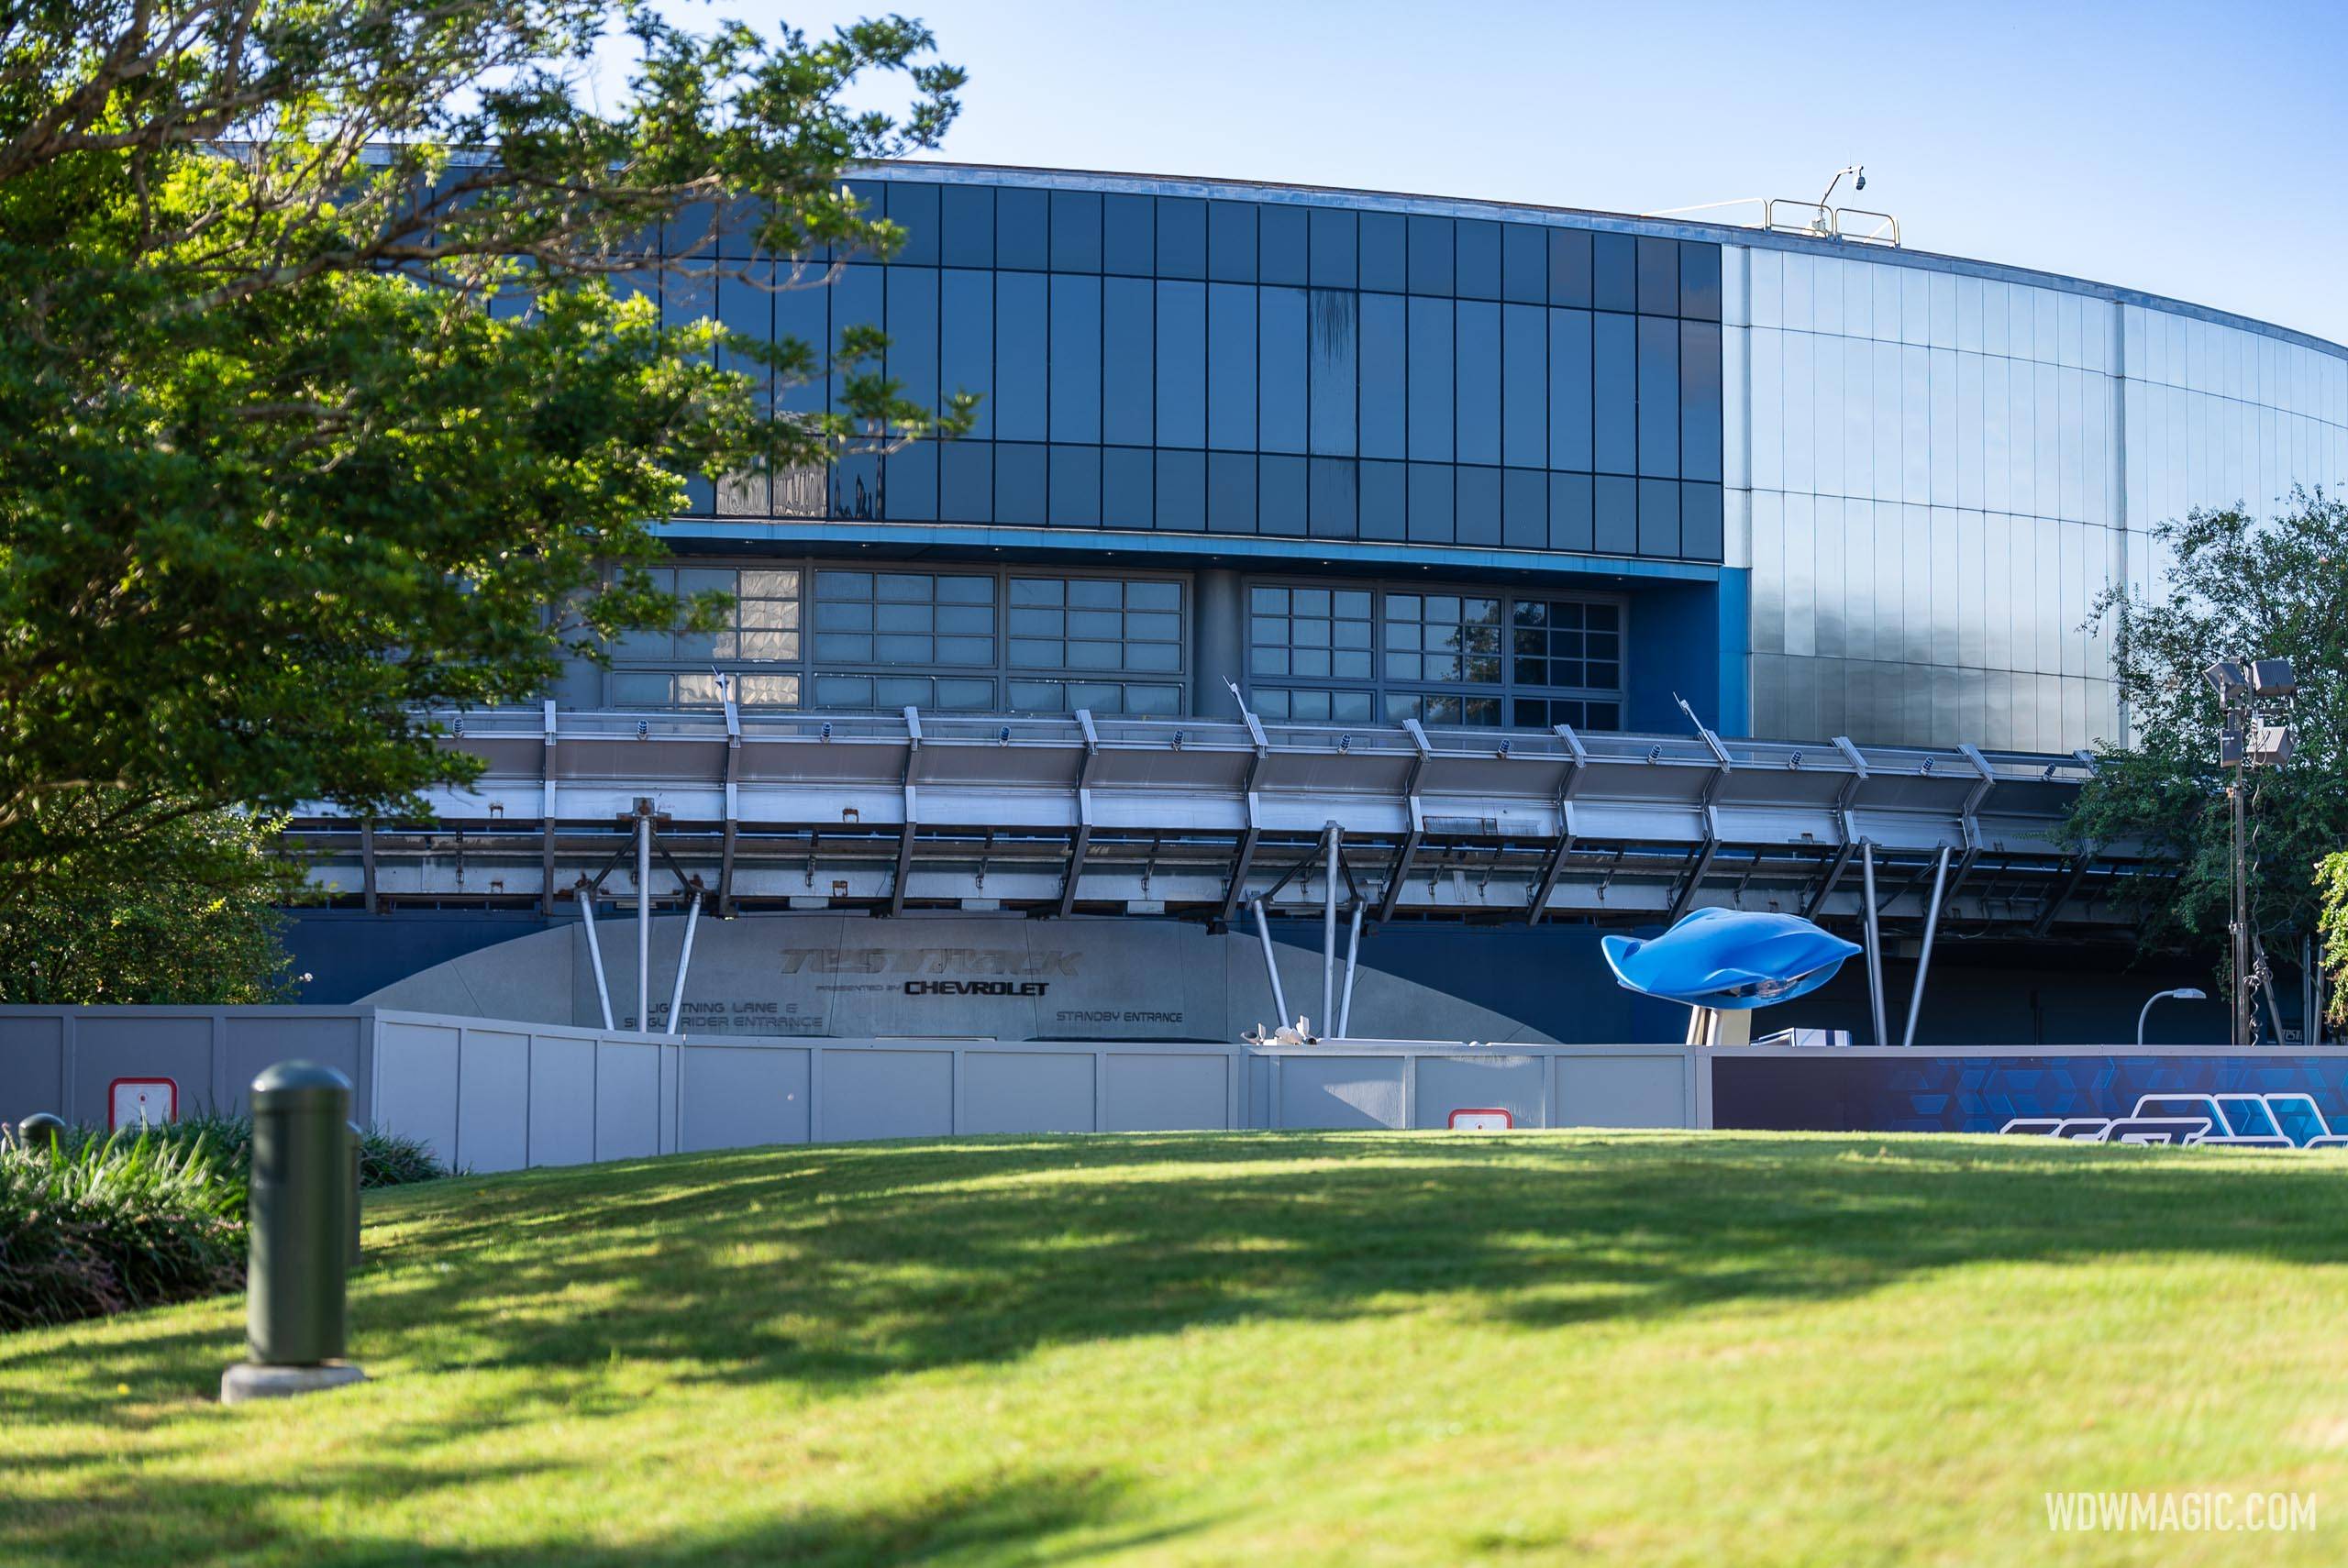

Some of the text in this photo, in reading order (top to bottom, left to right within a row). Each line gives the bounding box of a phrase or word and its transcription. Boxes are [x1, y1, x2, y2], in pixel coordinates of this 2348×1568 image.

[904, 981, 1049, 996] CHEVROLET
[648, 1002, 725, 1013] LIGTNING
[734, 1002, 777, 1013] LANE
[624, 1016, 823, 1028] SIGL RIDER ENTRANCE
[1057, 1011, 1182, 1022] STANDBY ENTRANCE
